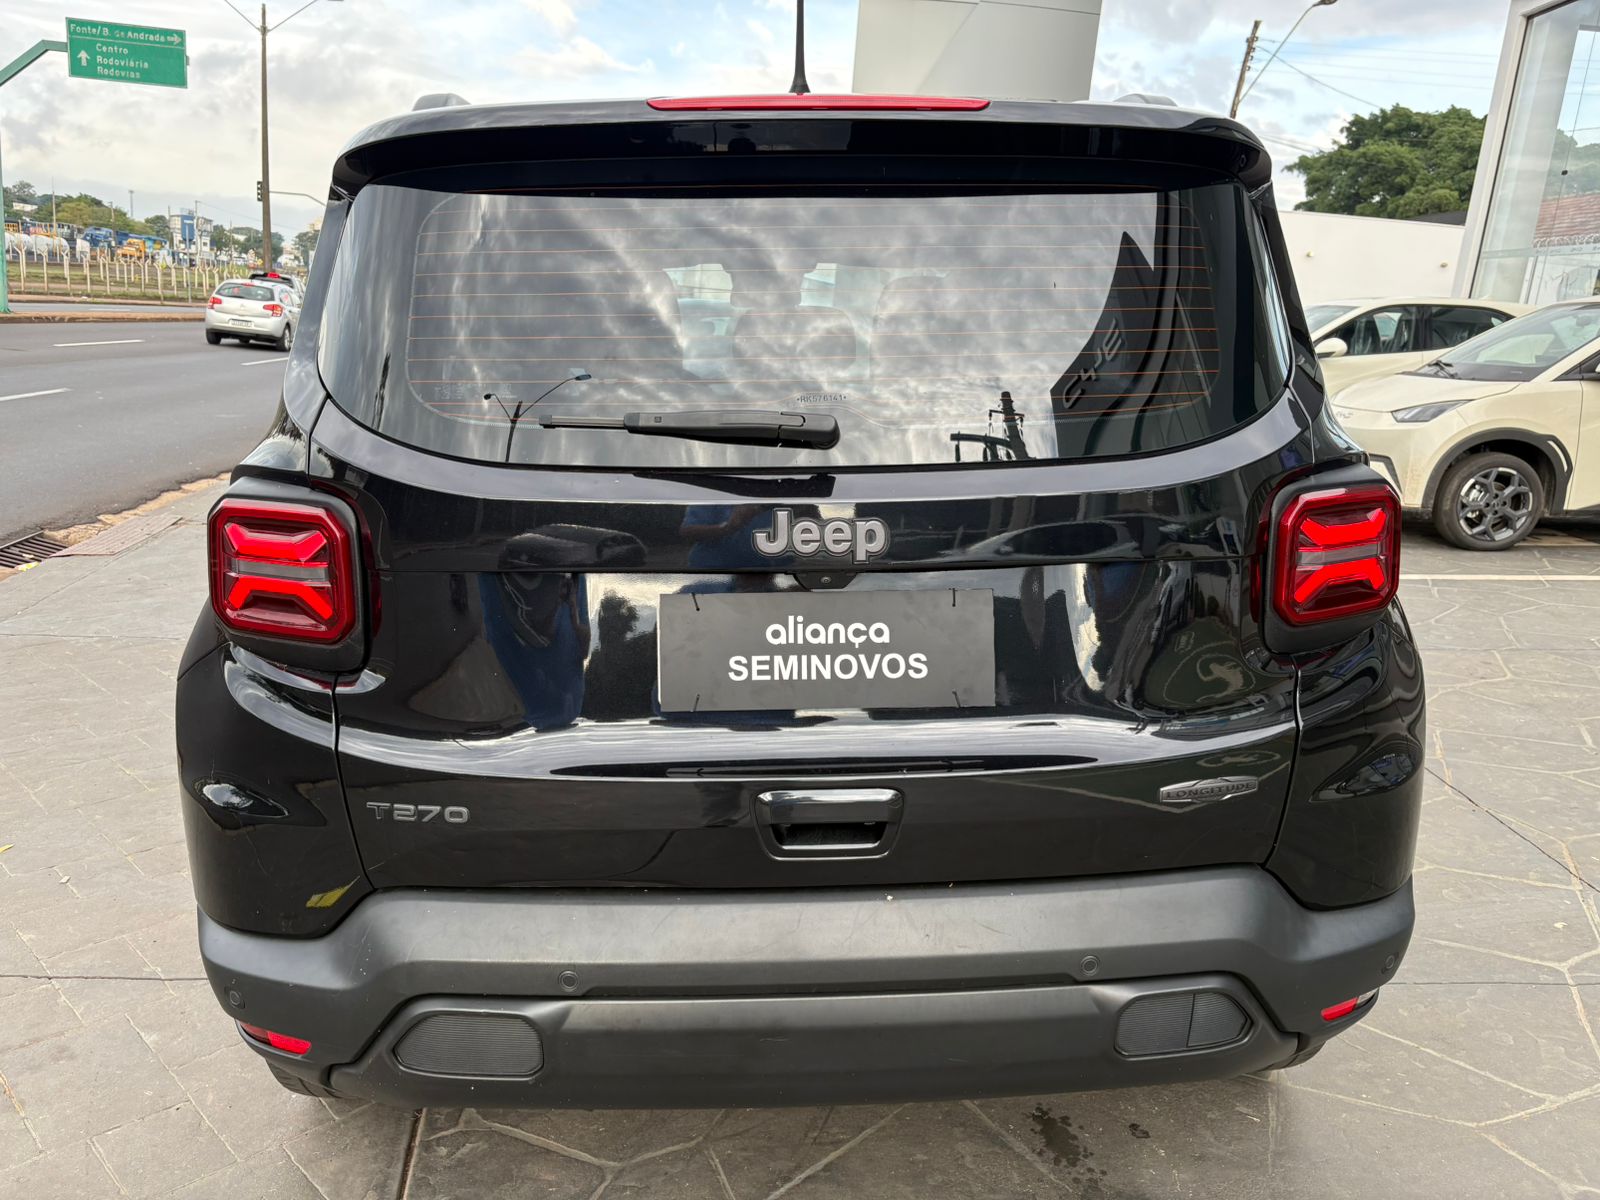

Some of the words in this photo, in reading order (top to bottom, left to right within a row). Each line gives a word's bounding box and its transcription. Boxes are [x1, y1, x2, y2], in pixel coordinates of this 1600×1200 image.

[96, 43, 129, 55] Centro
[97, 66, 141, 79] Rodovias
[752, 508, 889, 564] Jeep
[765, 615, 890, 648] aliança
[727, 652, 929, 682] SEMINOVOS
[1166, 782, 1253, 798] LONGITUDE
[366, 801, 470, 823] T270
